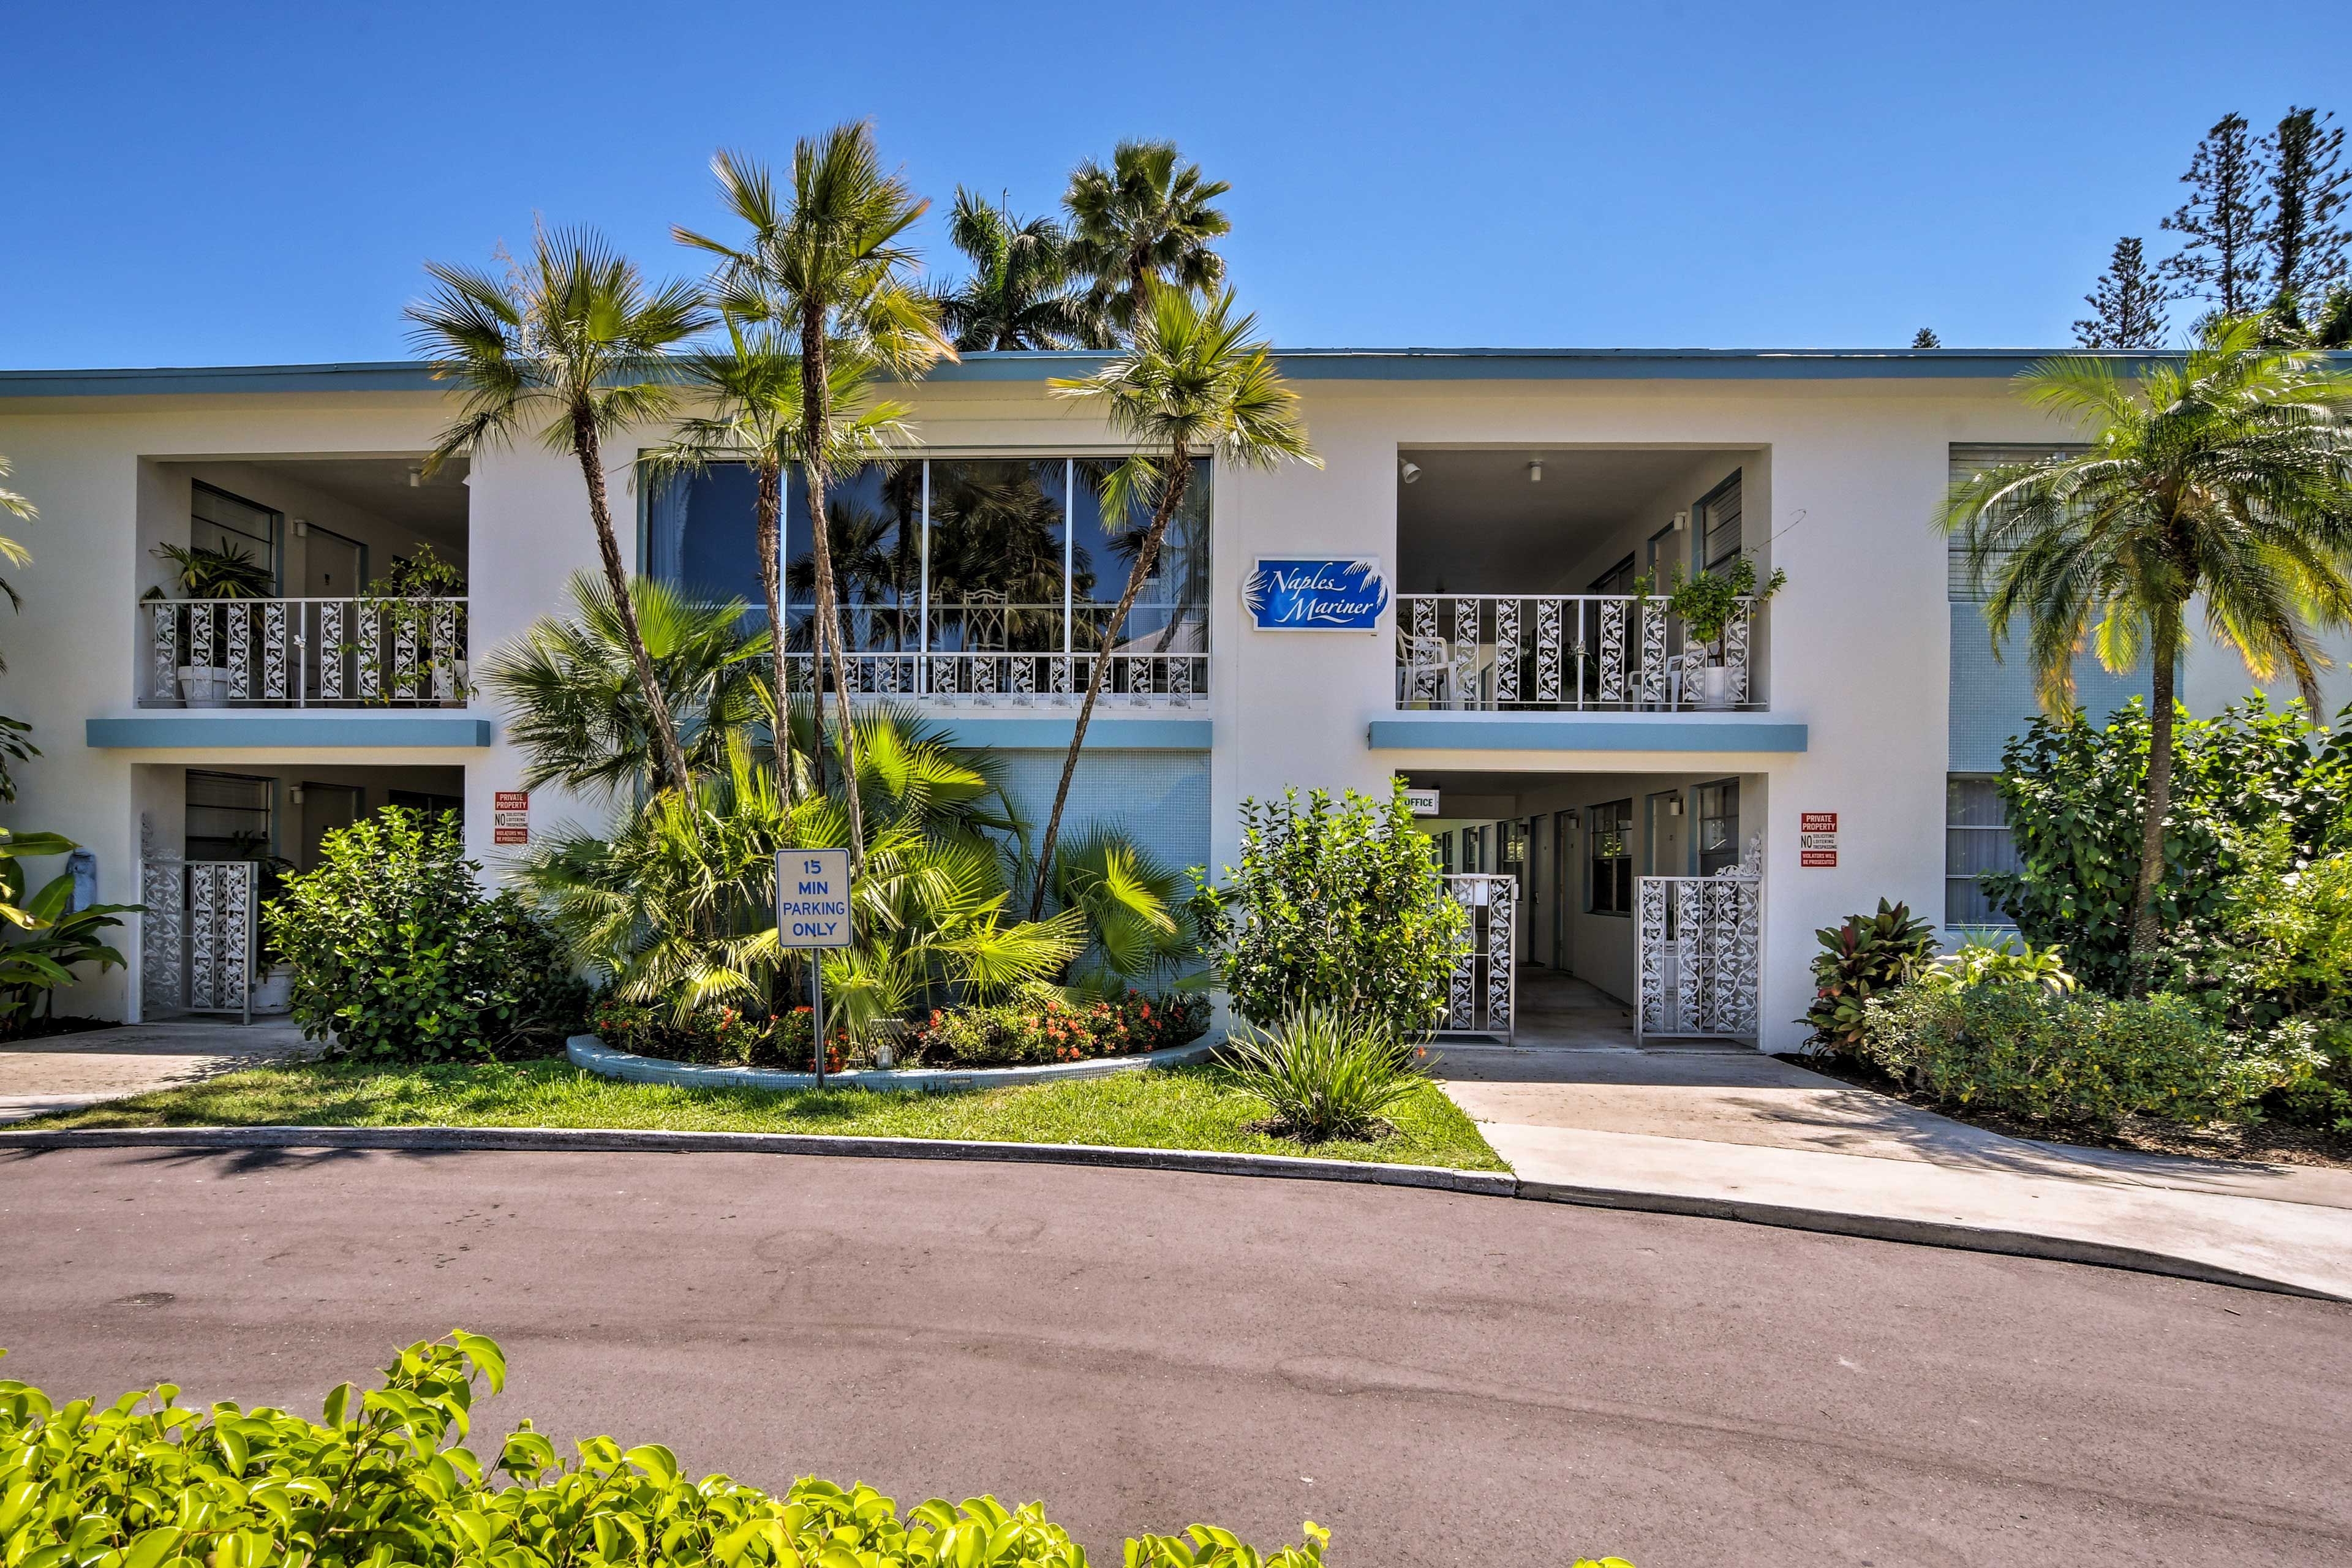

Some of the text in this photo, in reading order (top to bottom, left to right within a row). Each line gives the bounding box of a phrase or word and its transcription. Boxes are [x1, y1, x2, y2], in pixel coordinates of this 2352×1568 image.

[1267, 562, 1347, 601] Naples
[1274, 597, 1373, 623] Mariner
[1404, 798, 1433, 807] OFFICE
[495, 813, 506, 826] NO
[1801, 835, 1812, 848] NO
[804, 861, 821, 874] 15
[799, 881, 828, 895] MIN
[783, 902, 845, 916] PARKING
[793, 922, 837, 936] ONLY
